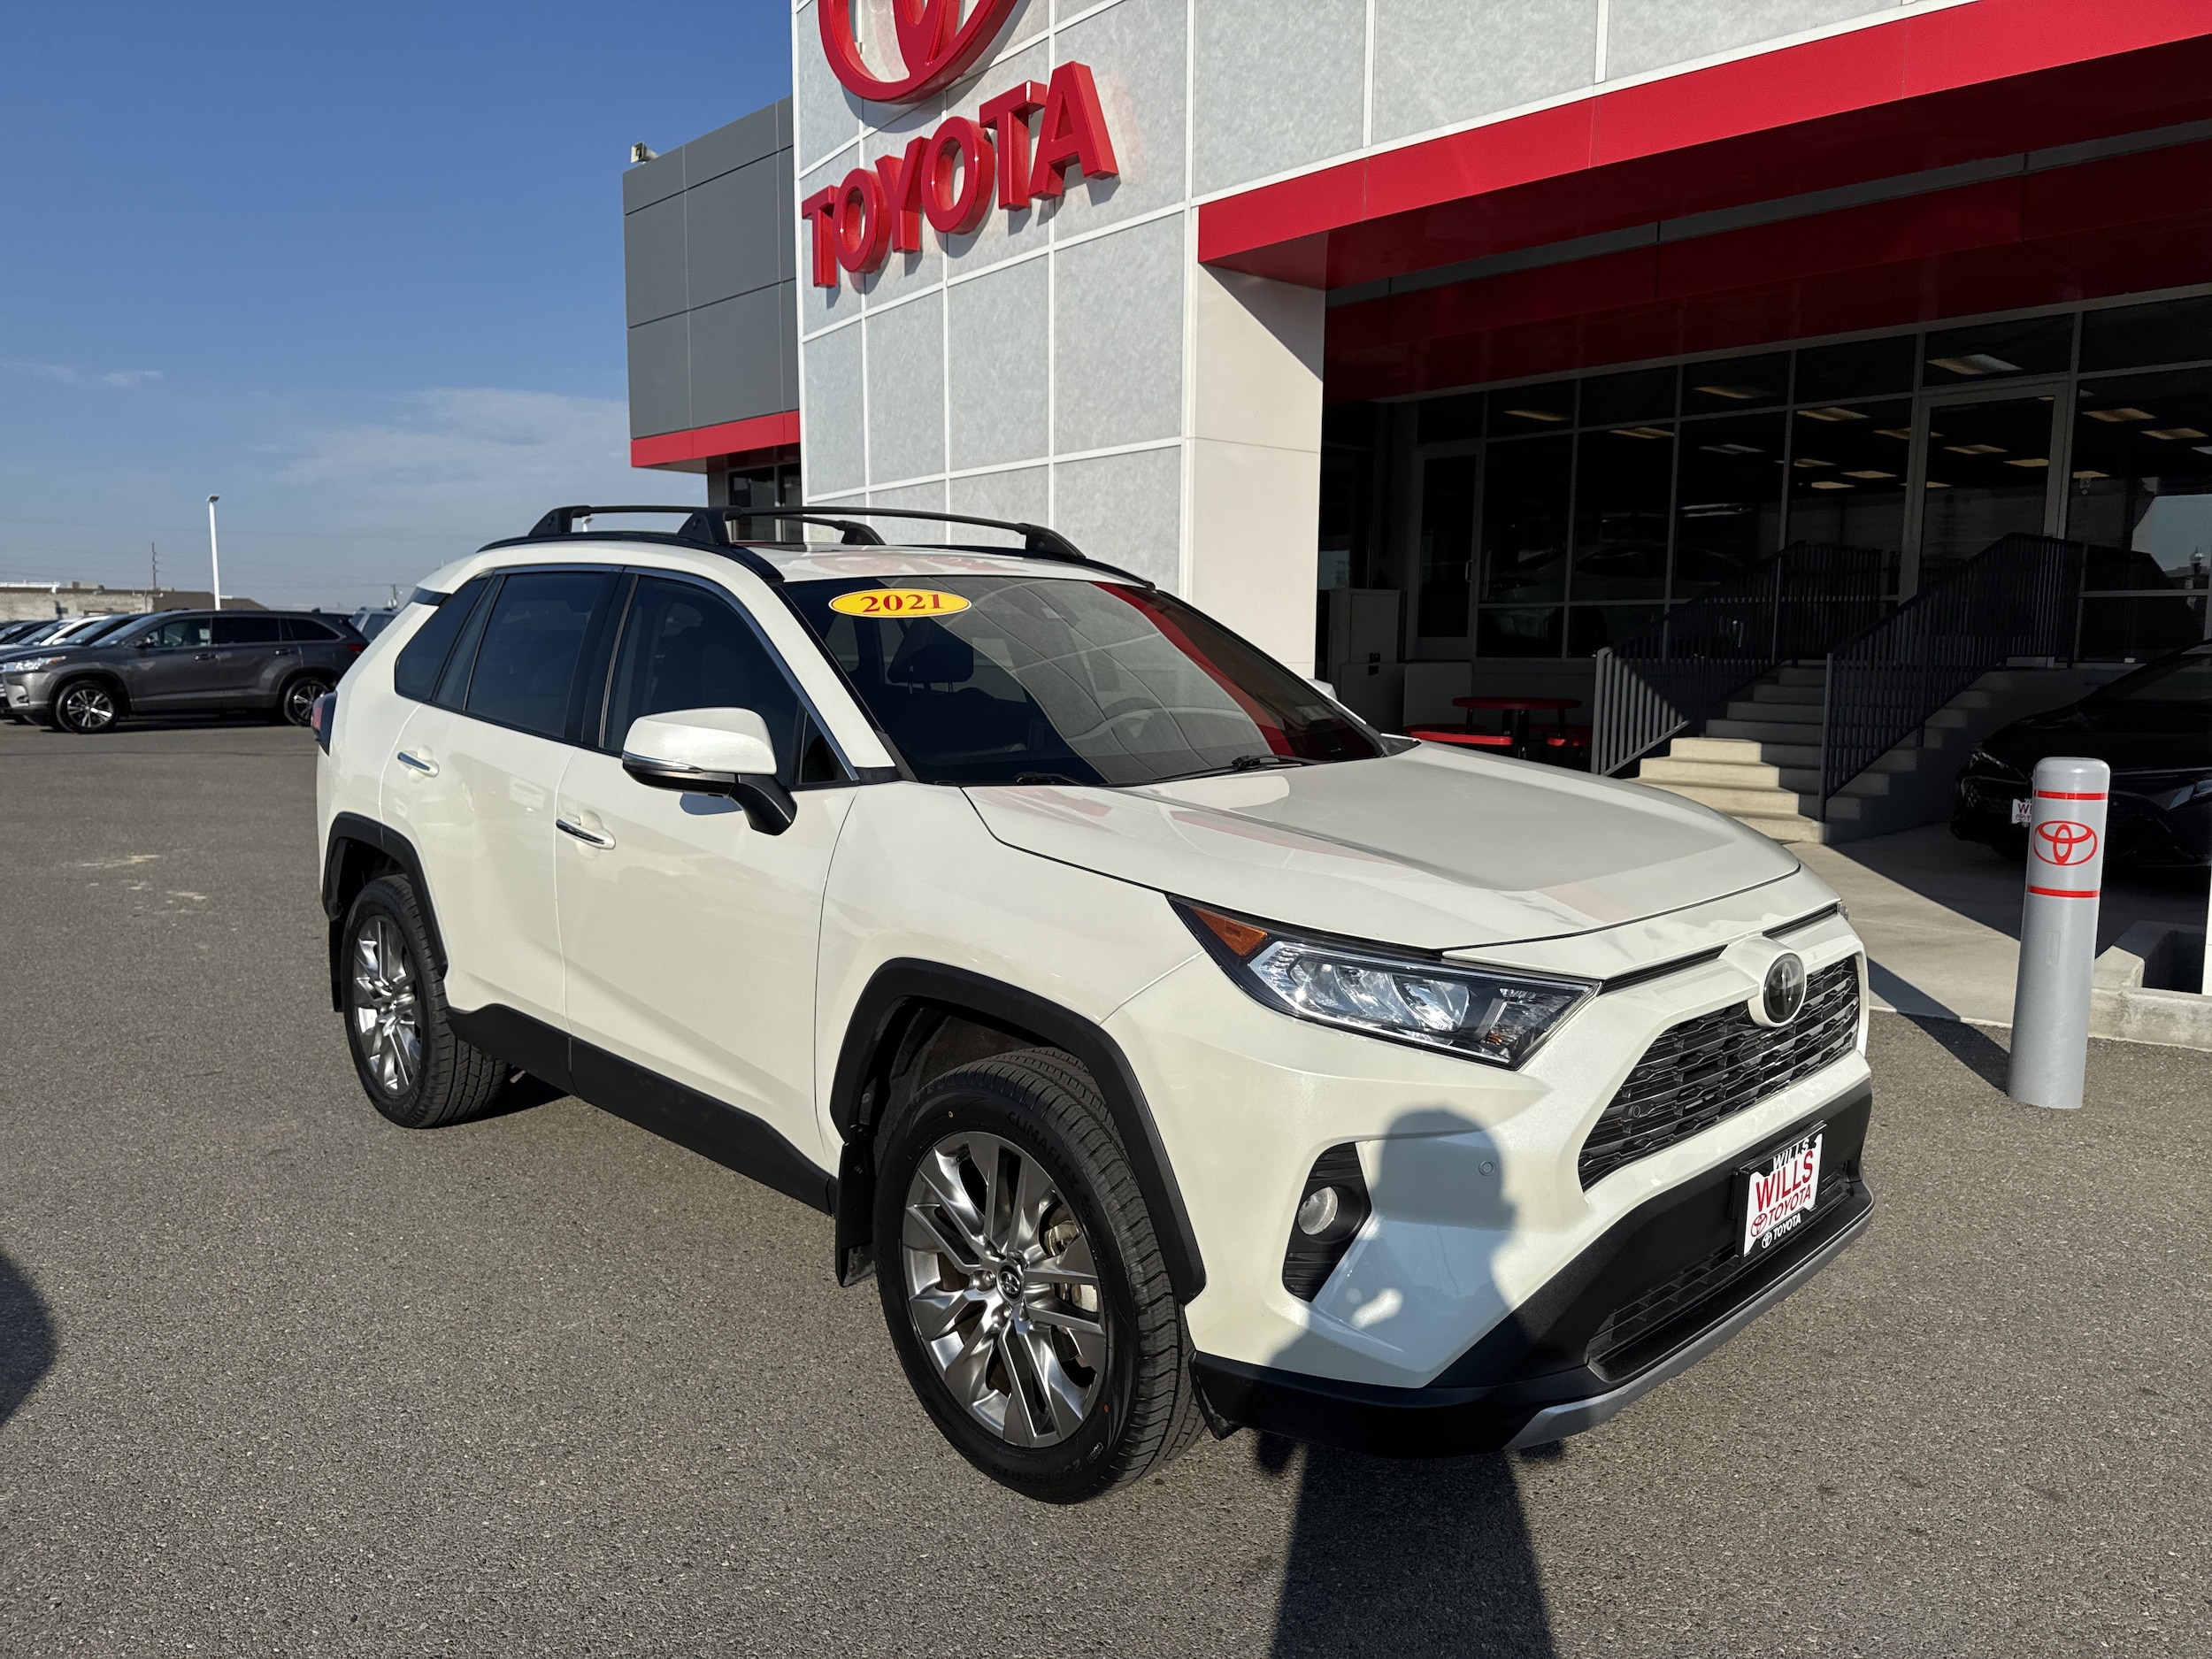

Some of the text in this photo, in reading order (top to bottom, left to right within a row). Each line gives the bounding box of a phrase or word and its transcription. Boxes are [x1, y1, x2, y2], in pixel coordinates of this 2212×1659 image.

[802, 61, 1118, 288] TOYOTA
[860, 594, 944, 613] 2021
[1008, 1110, 1079, 1189] CLIMAFLEX
[1773, 1138, 1809, 1171] WILLS
[1755, 1149, 1813, 1213] WILLS
[1769, 1184, 1811, 1226] TOYOTA
[1773, 1212, 1801, 1240] TOYOTA
